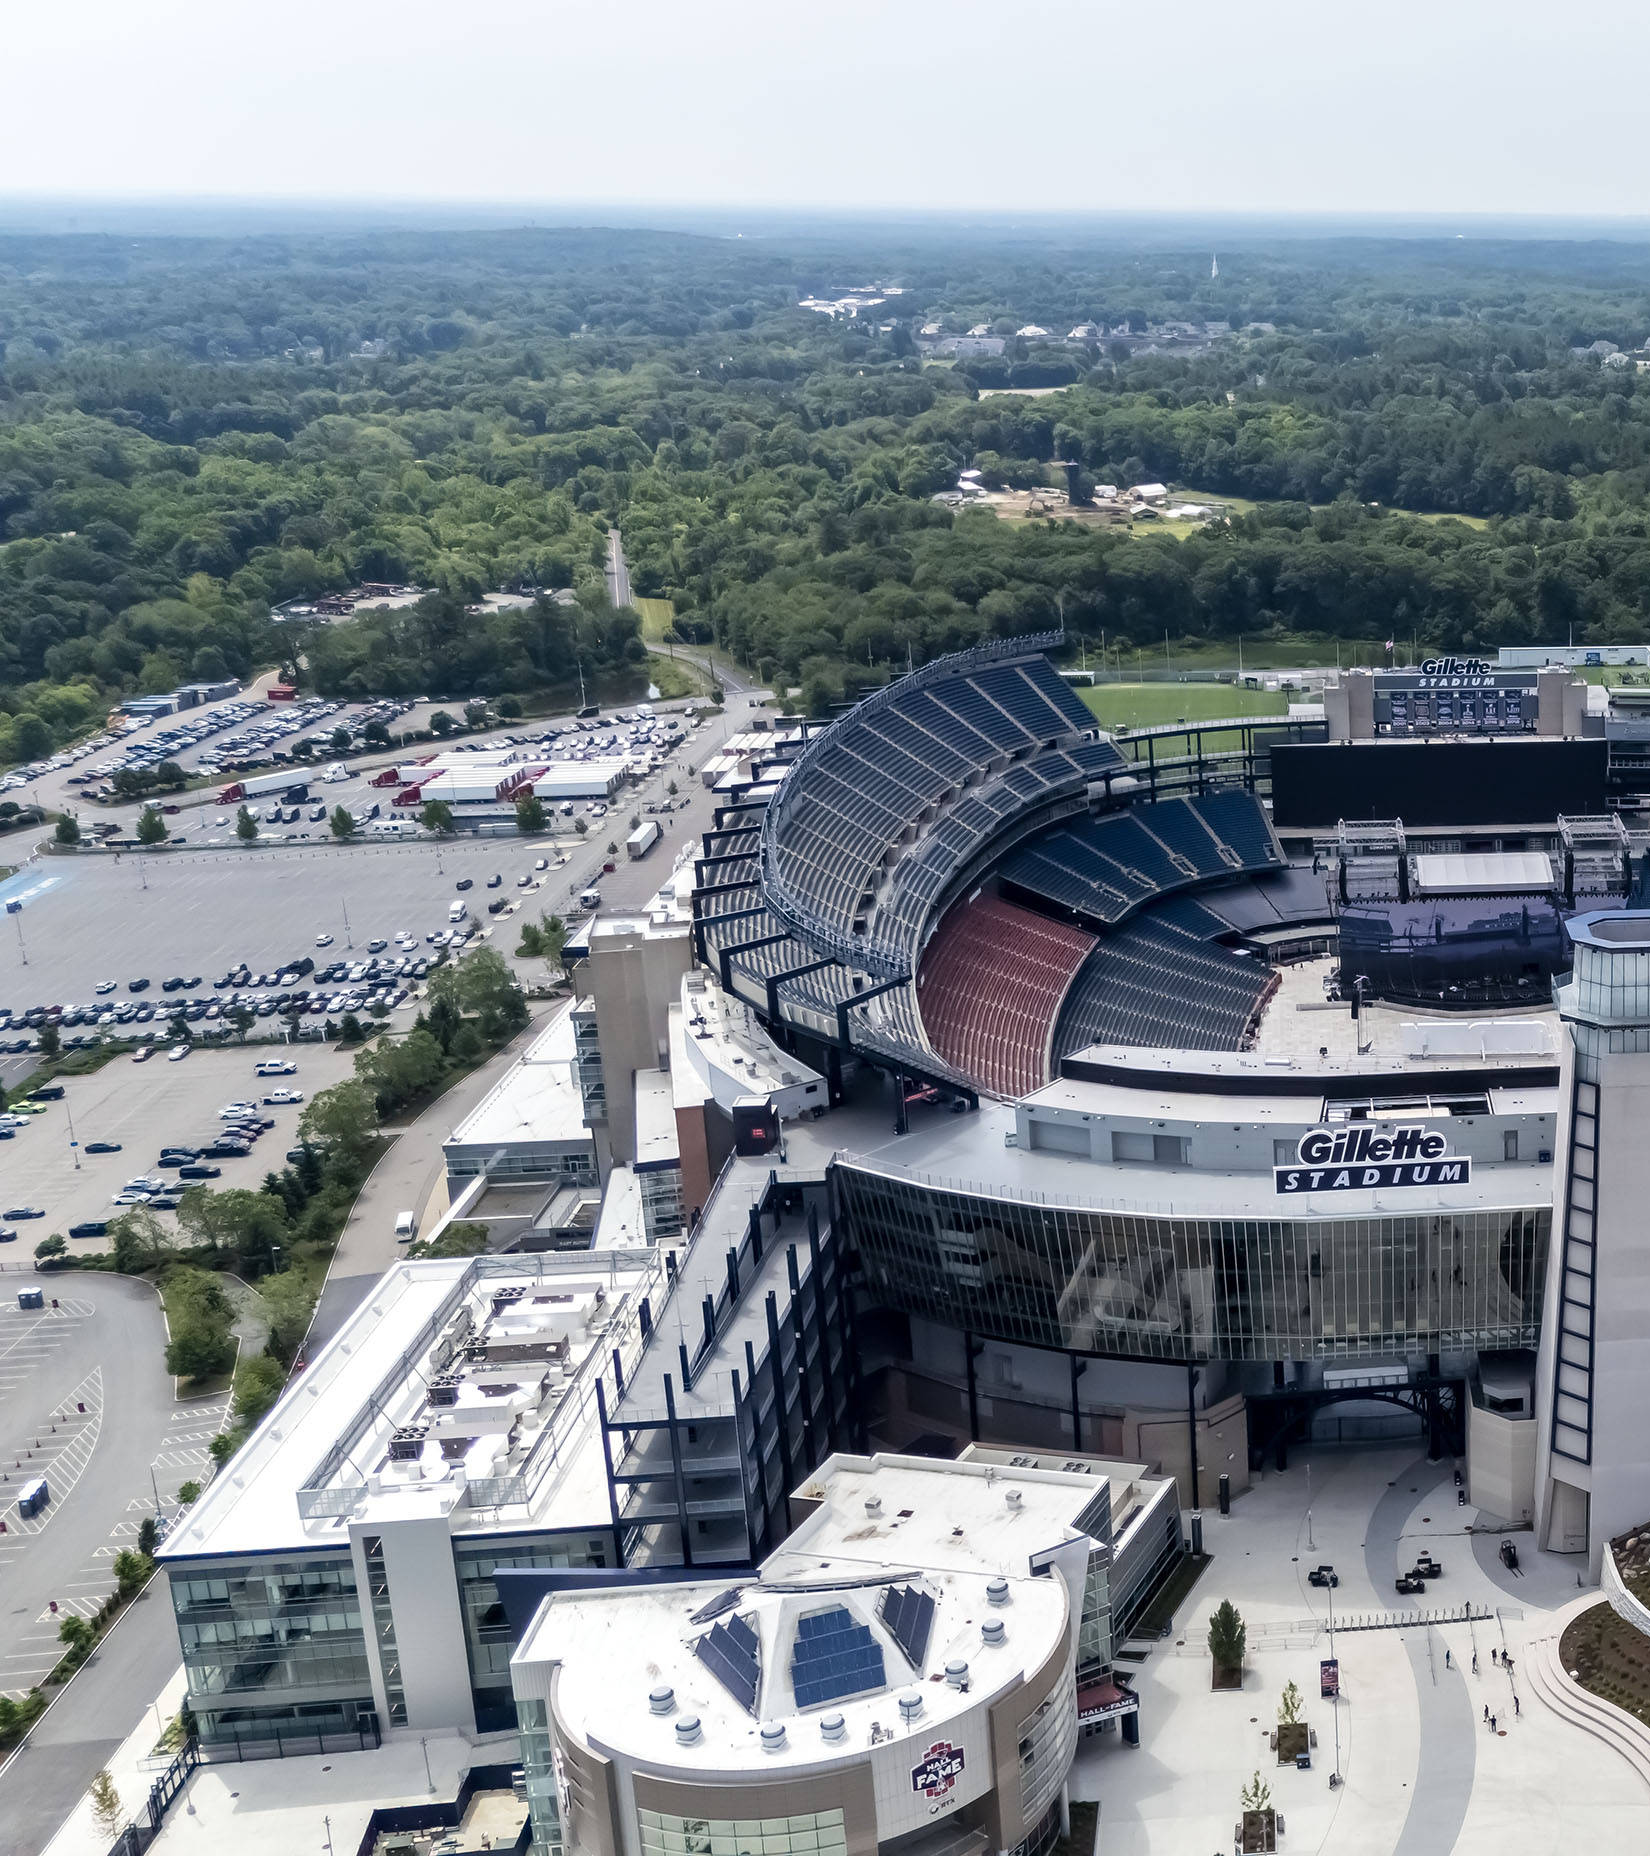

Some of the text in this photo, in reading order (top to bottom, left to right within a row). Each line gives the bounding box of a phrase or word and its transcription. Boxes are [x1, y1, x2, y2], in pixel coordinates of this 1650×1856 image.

[1421, 658, 1491, 675] Gillette
[1418, 677, 1496, 687] STADIUM
[1299, 1127, 1447, 1165] Gillette
[1284, 1164, 1463, 1191] STADIUM
[1080, 1707, 1105, 1718] HALL
[1110, 1698, 1136, 1710] FAME
[916, 1758, 962, 1790] FAME
[926, 1756, 952, 1772] HALL
